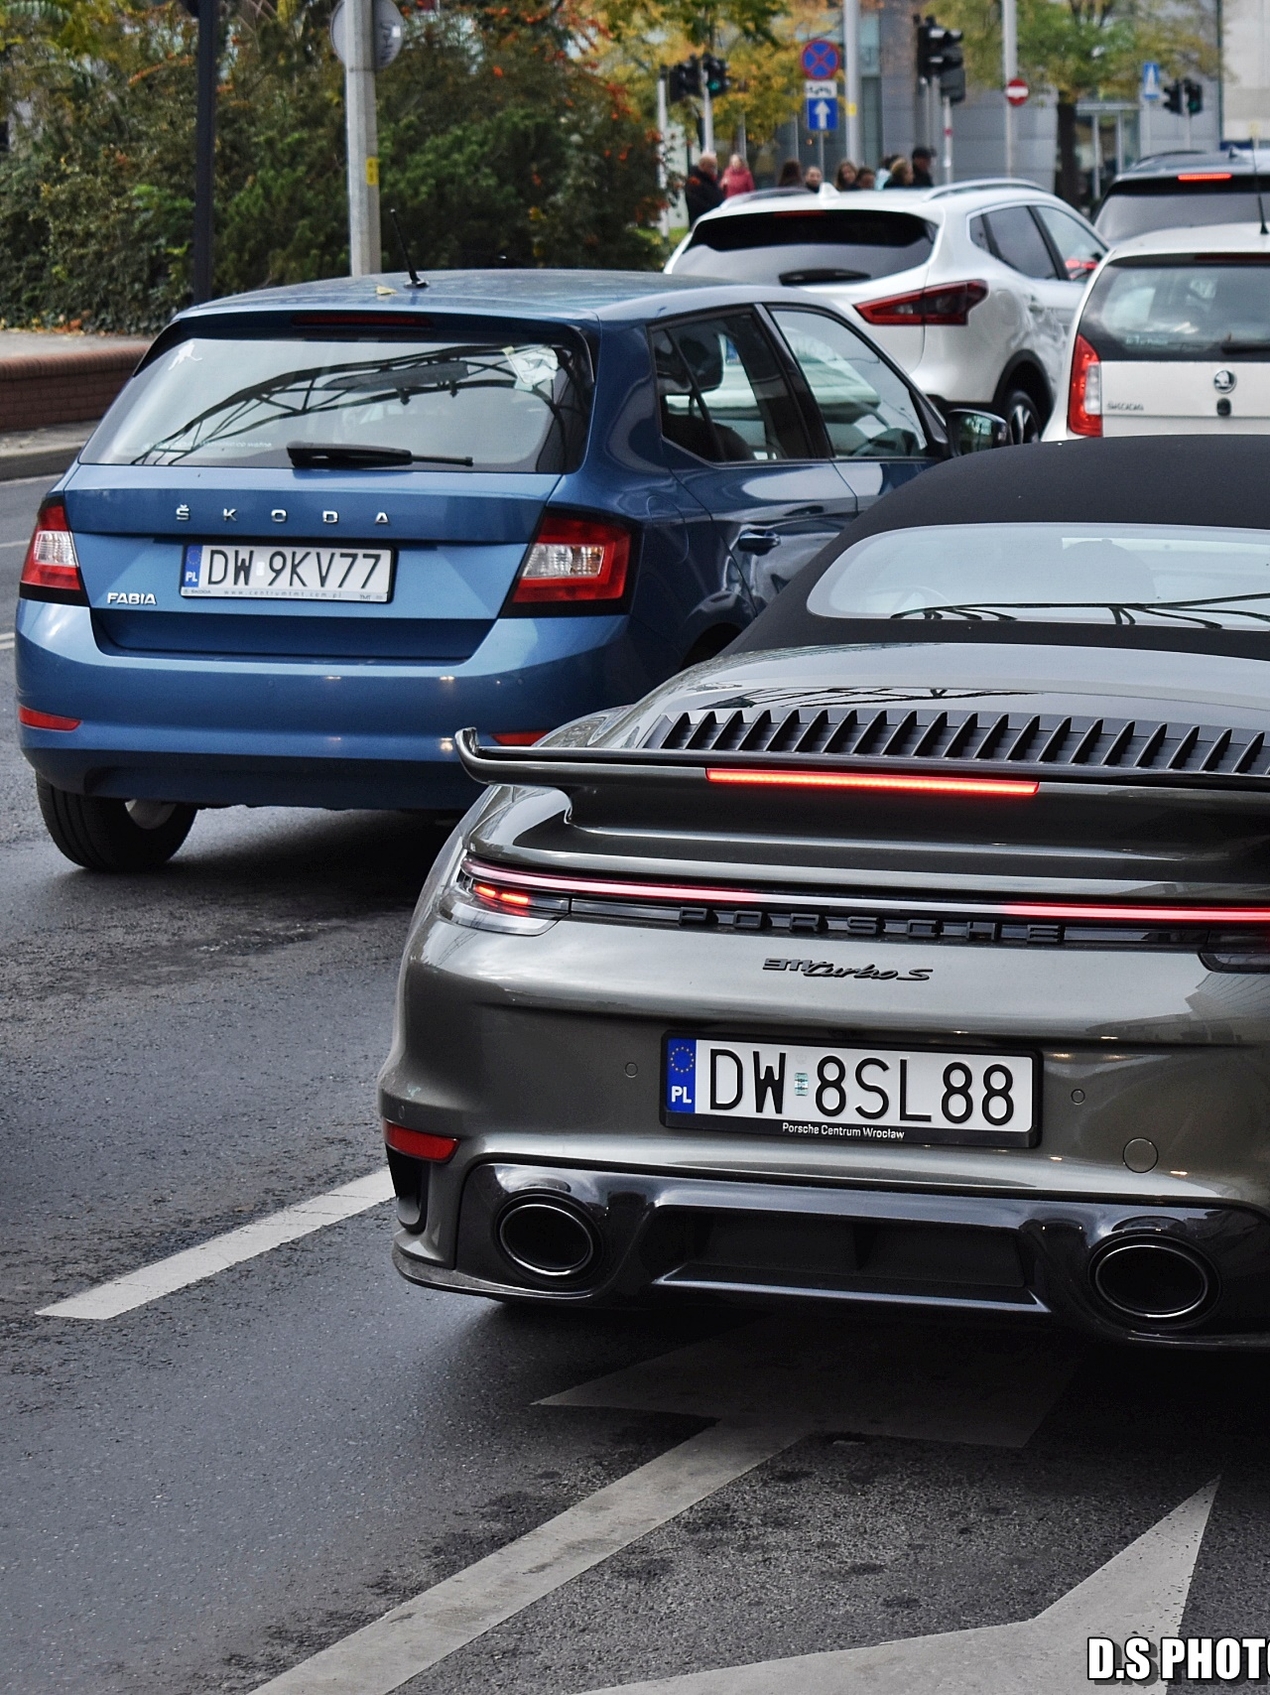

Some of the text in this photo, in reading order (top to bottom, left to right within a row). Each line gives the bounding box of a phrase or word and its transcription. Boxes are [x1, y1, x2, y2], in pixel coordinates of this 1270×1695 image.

[176, 504, 390, 525] ŠKODA
[185, 571, 198, 583] PL
[207, 549, 382, 590] DW 9KV77
[107, 592, 158, 606] FABIA
[678, 907, 1064, 944] PORSCHE
[896, 968, 934, 982] S
[671, 1085, 692, 1104] PL
[709, 1048, 1015, 1126] DW 8SL88
[782, 1122, 905, 1140] Porsche Centrum Wrocław
